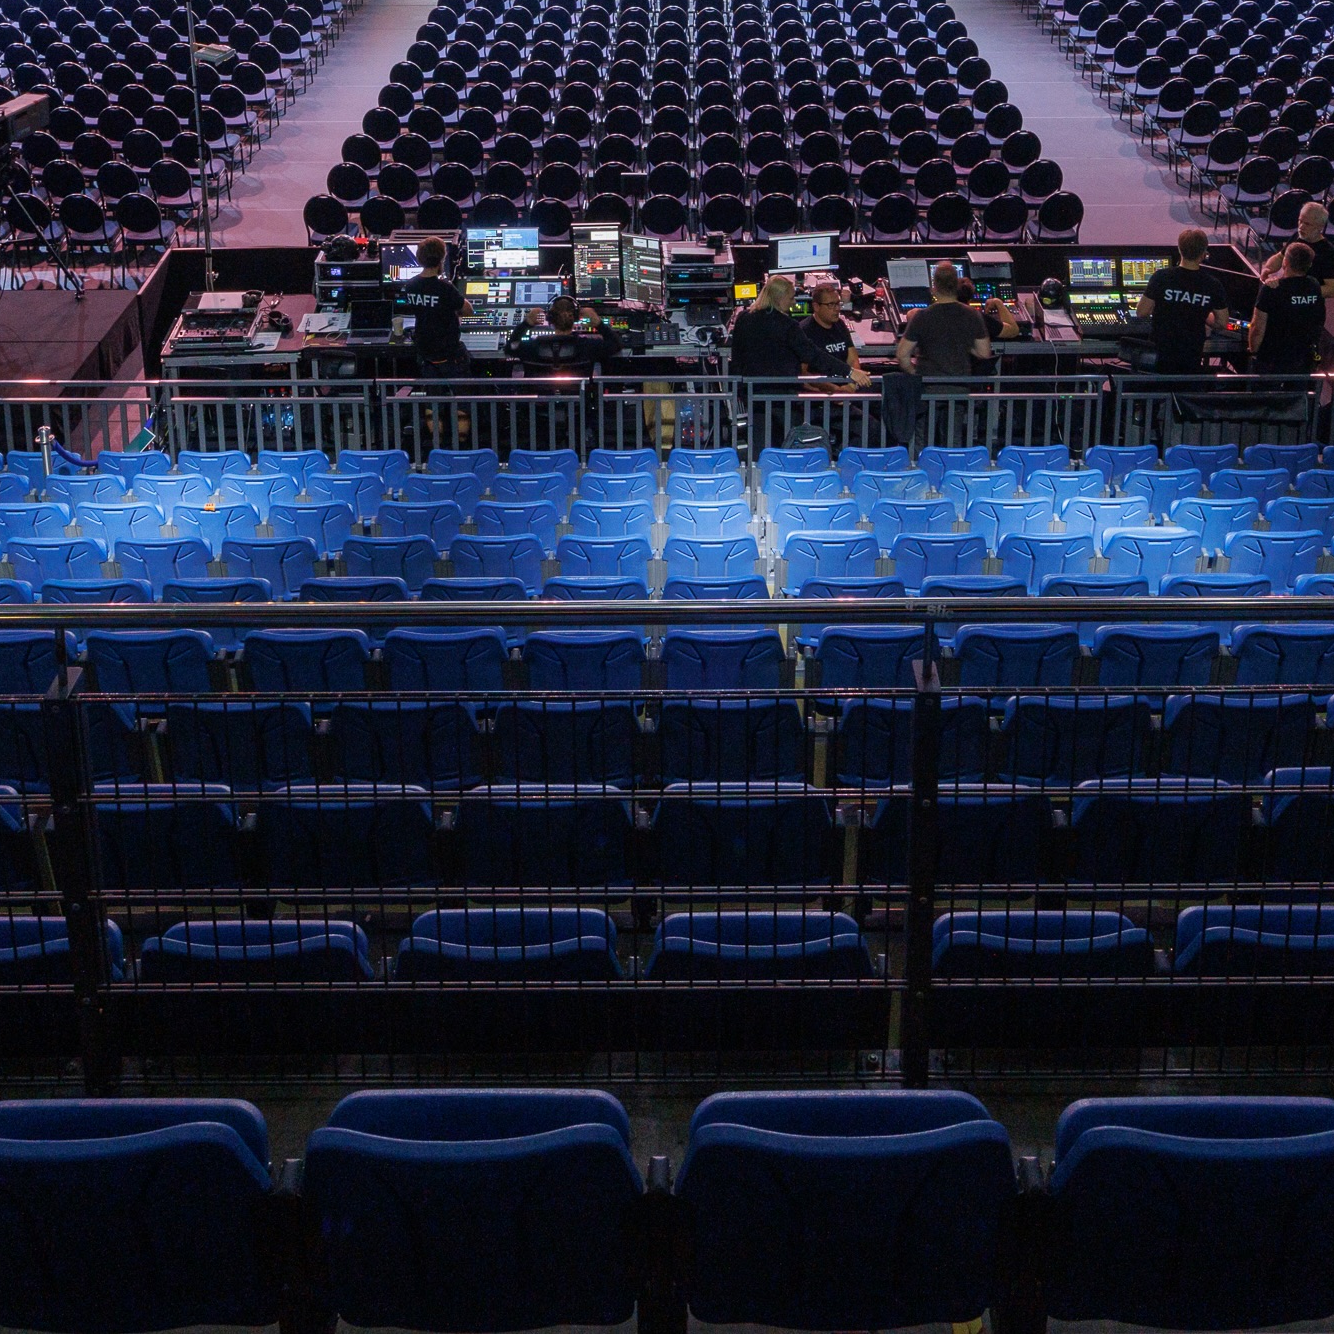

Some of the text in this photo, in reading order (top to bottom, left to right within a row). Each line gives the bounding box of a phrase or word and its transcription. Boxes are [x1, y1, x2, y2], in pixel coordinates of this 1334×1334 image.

[472, 284, 483, 292] 23
[407, 293, 439, 307] STAFF
[1163, 289, 1211, 306] STAFF
[1291, 295, 1318, 304] STAFF
[825, 342, 846, 352] STAFF
